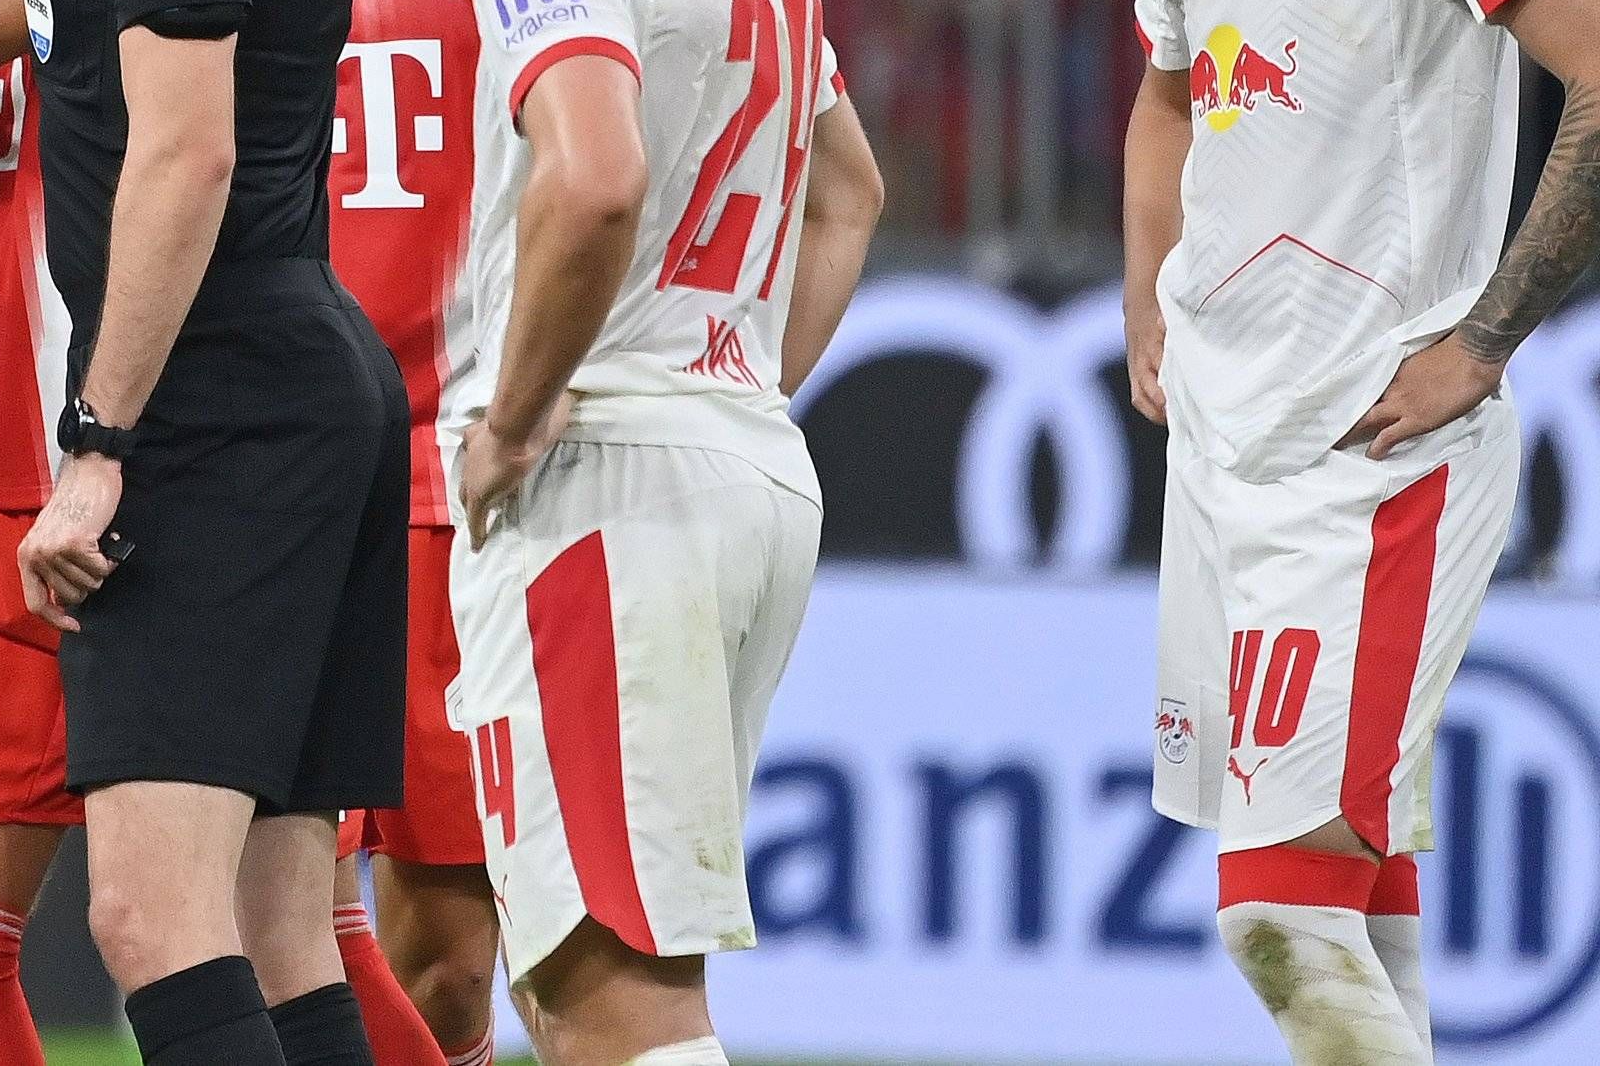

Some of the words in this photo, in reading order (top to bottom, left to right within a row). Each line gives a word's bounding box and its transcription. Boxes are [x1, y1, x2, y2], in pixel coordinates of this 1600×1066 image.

[505, 4, 589, 50] kraken
[1228, 627, 1322, 749] 40
[750, 754, 1218, 959] anz
